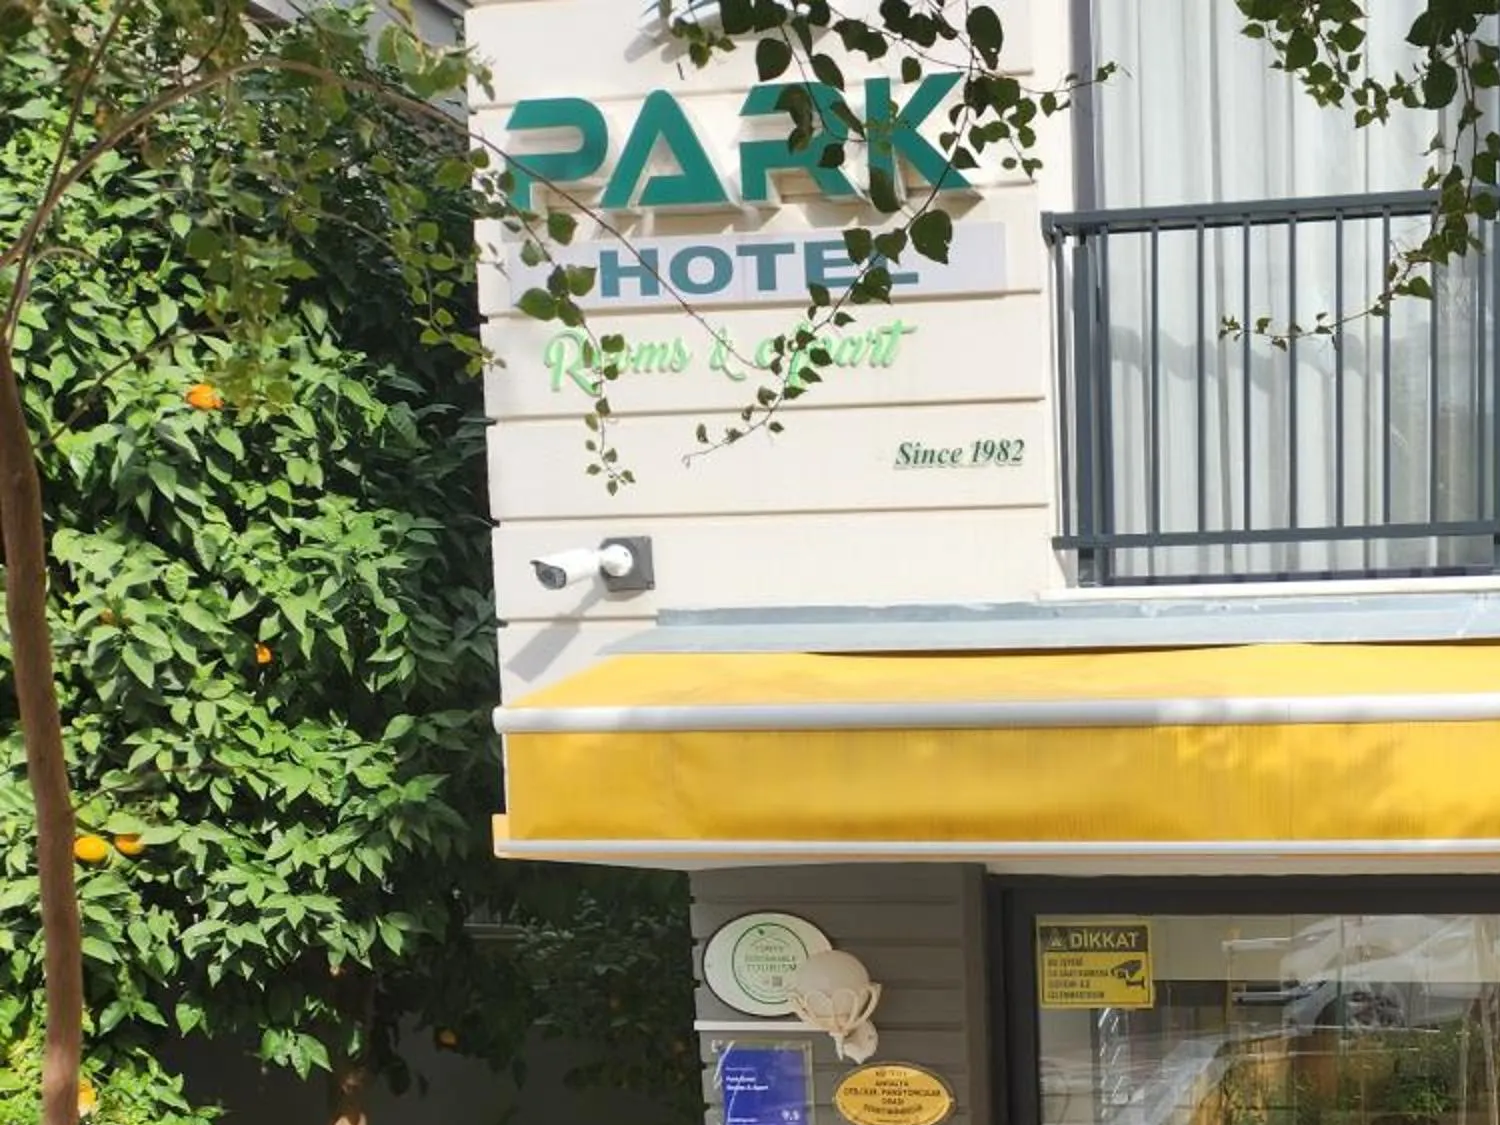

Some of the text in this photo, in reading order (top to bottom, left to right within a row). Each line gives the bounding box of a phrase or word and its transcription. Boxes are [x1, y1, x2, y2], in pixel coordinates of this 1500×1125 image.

[505, 72, 972, 210] PARK
[895, 438, 1025, 466] Since 1982
[1071, 928, 1138, 949] DİKKAT
